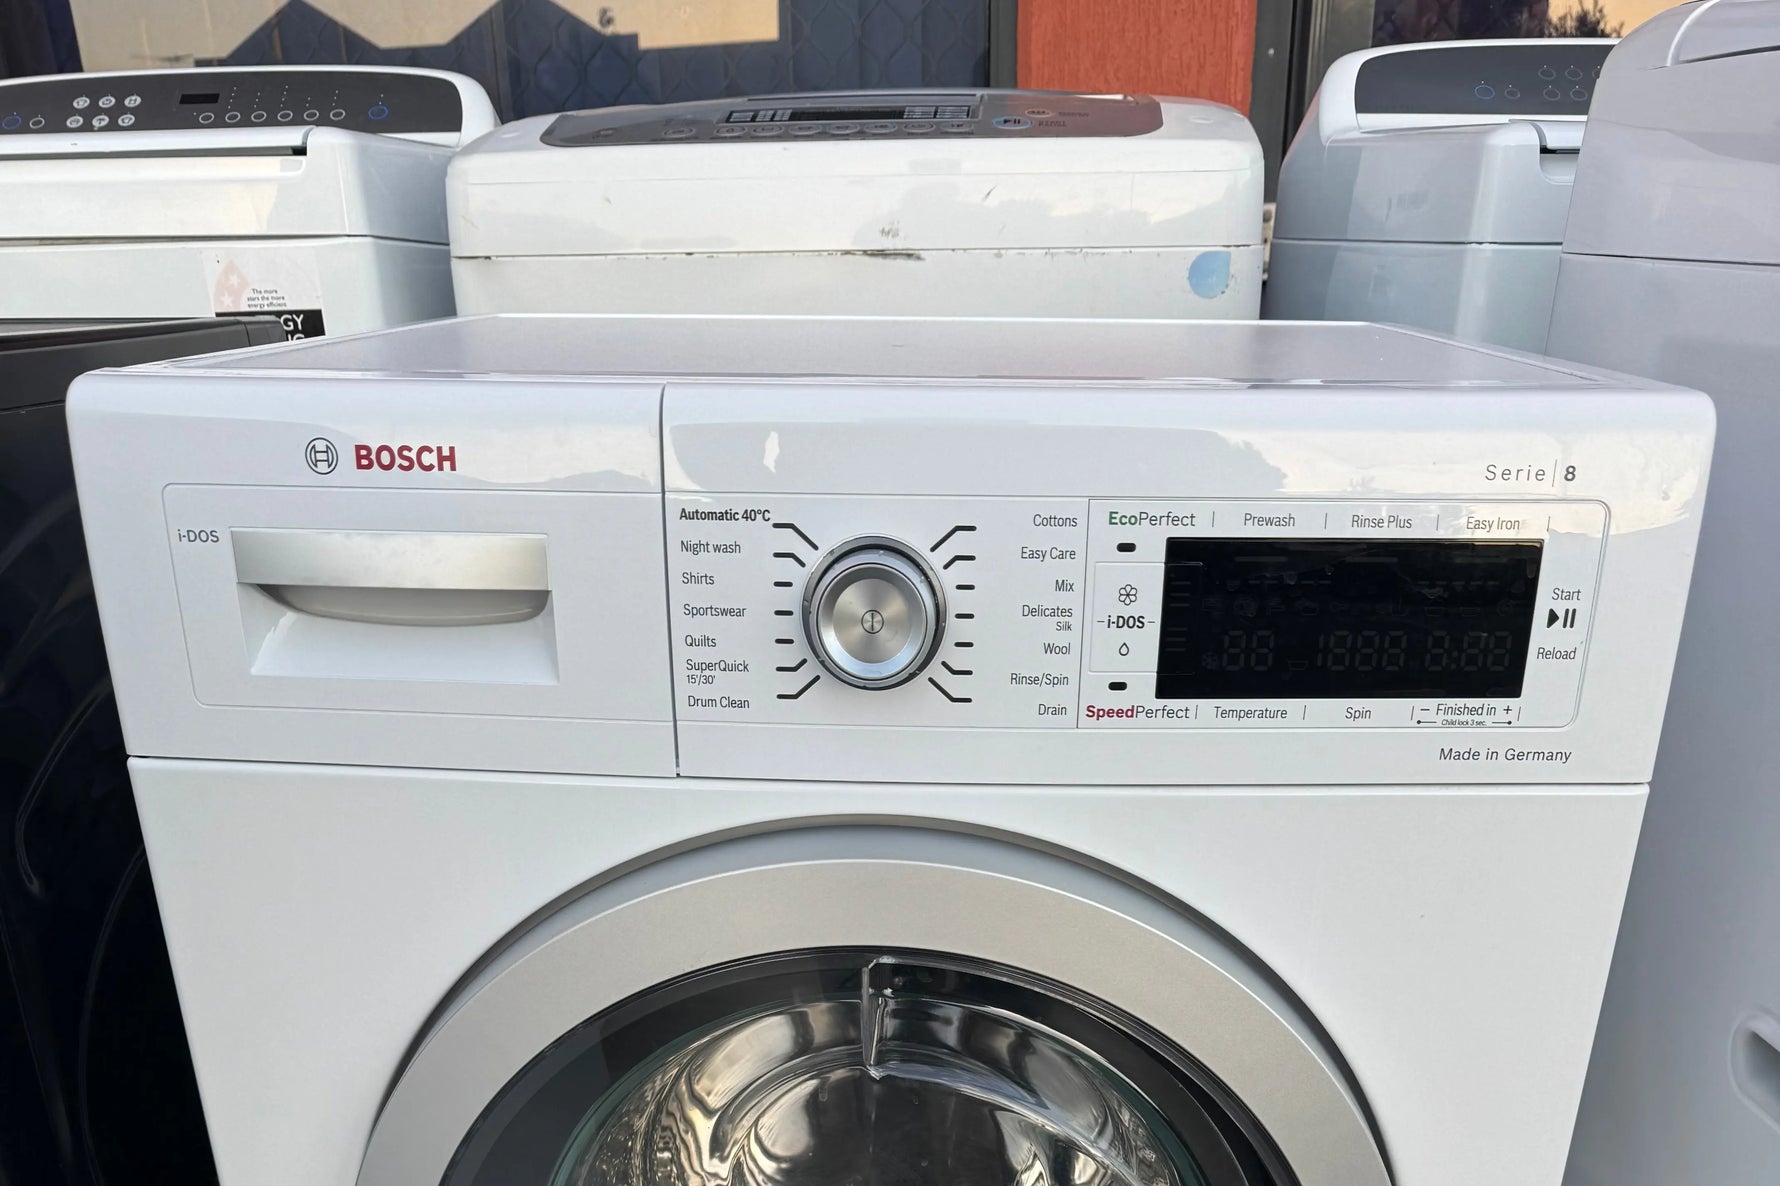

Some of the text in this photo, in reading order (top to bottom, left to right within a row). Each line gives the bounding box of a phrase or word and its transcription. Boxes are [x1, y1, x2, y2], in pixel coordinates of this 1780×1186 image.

[354, 444, 457, 472] BOSCH
[1485, 464, 1577, 482] Serie 8
[679, 507, 771, 522] Automatic 40°C
[1033, 513, 1078, 527] Cottons
[1108, 511, 1196, 527] EcoPerfect
[1243, 512, 1296, 527] Prewash
[1351, 514, 1413, 529] Rinse Plus
[1466, 516, 1520, 533] Easy Iron
[177, 528, 220, 543] i-DOS
[680, 540, 741, 556] Night wash
[1020, 546, 1076, 562] Easy Care
[681, 572, 715, 585] Shirts
[1055, 579, 1075, 593] Mix
[1551, 587, 1582, 601] Start
[683, 604, 747, 618] Sportswear
[1022, 604, 1073, 618] Delicates
[1055, 621, 1072, 632] Silk
[1106, 615, 1146, 629] i-DOS
[684, 634, 717, 648] Quilts
[1043, 642, 1071, 655] Wool
[1536, 647, 1577, 660] Reload
[686, 659, 749, 674] SuperQuick
[1010, 672, 1069, 688] Rinse/Spin
[688, 695, 750, 709] Drum Clean
[1038, 703, 1067, 716] Drain
[1435, 703, 1497, 716] Finished in
[1085, 705, 1190, 720] SpeedPerfect
[1214, 706, 1288, 721] Temperature
[1344, 706, 1372, 722] Spin
[1439, 747, 1572, 764] Made in Germany
